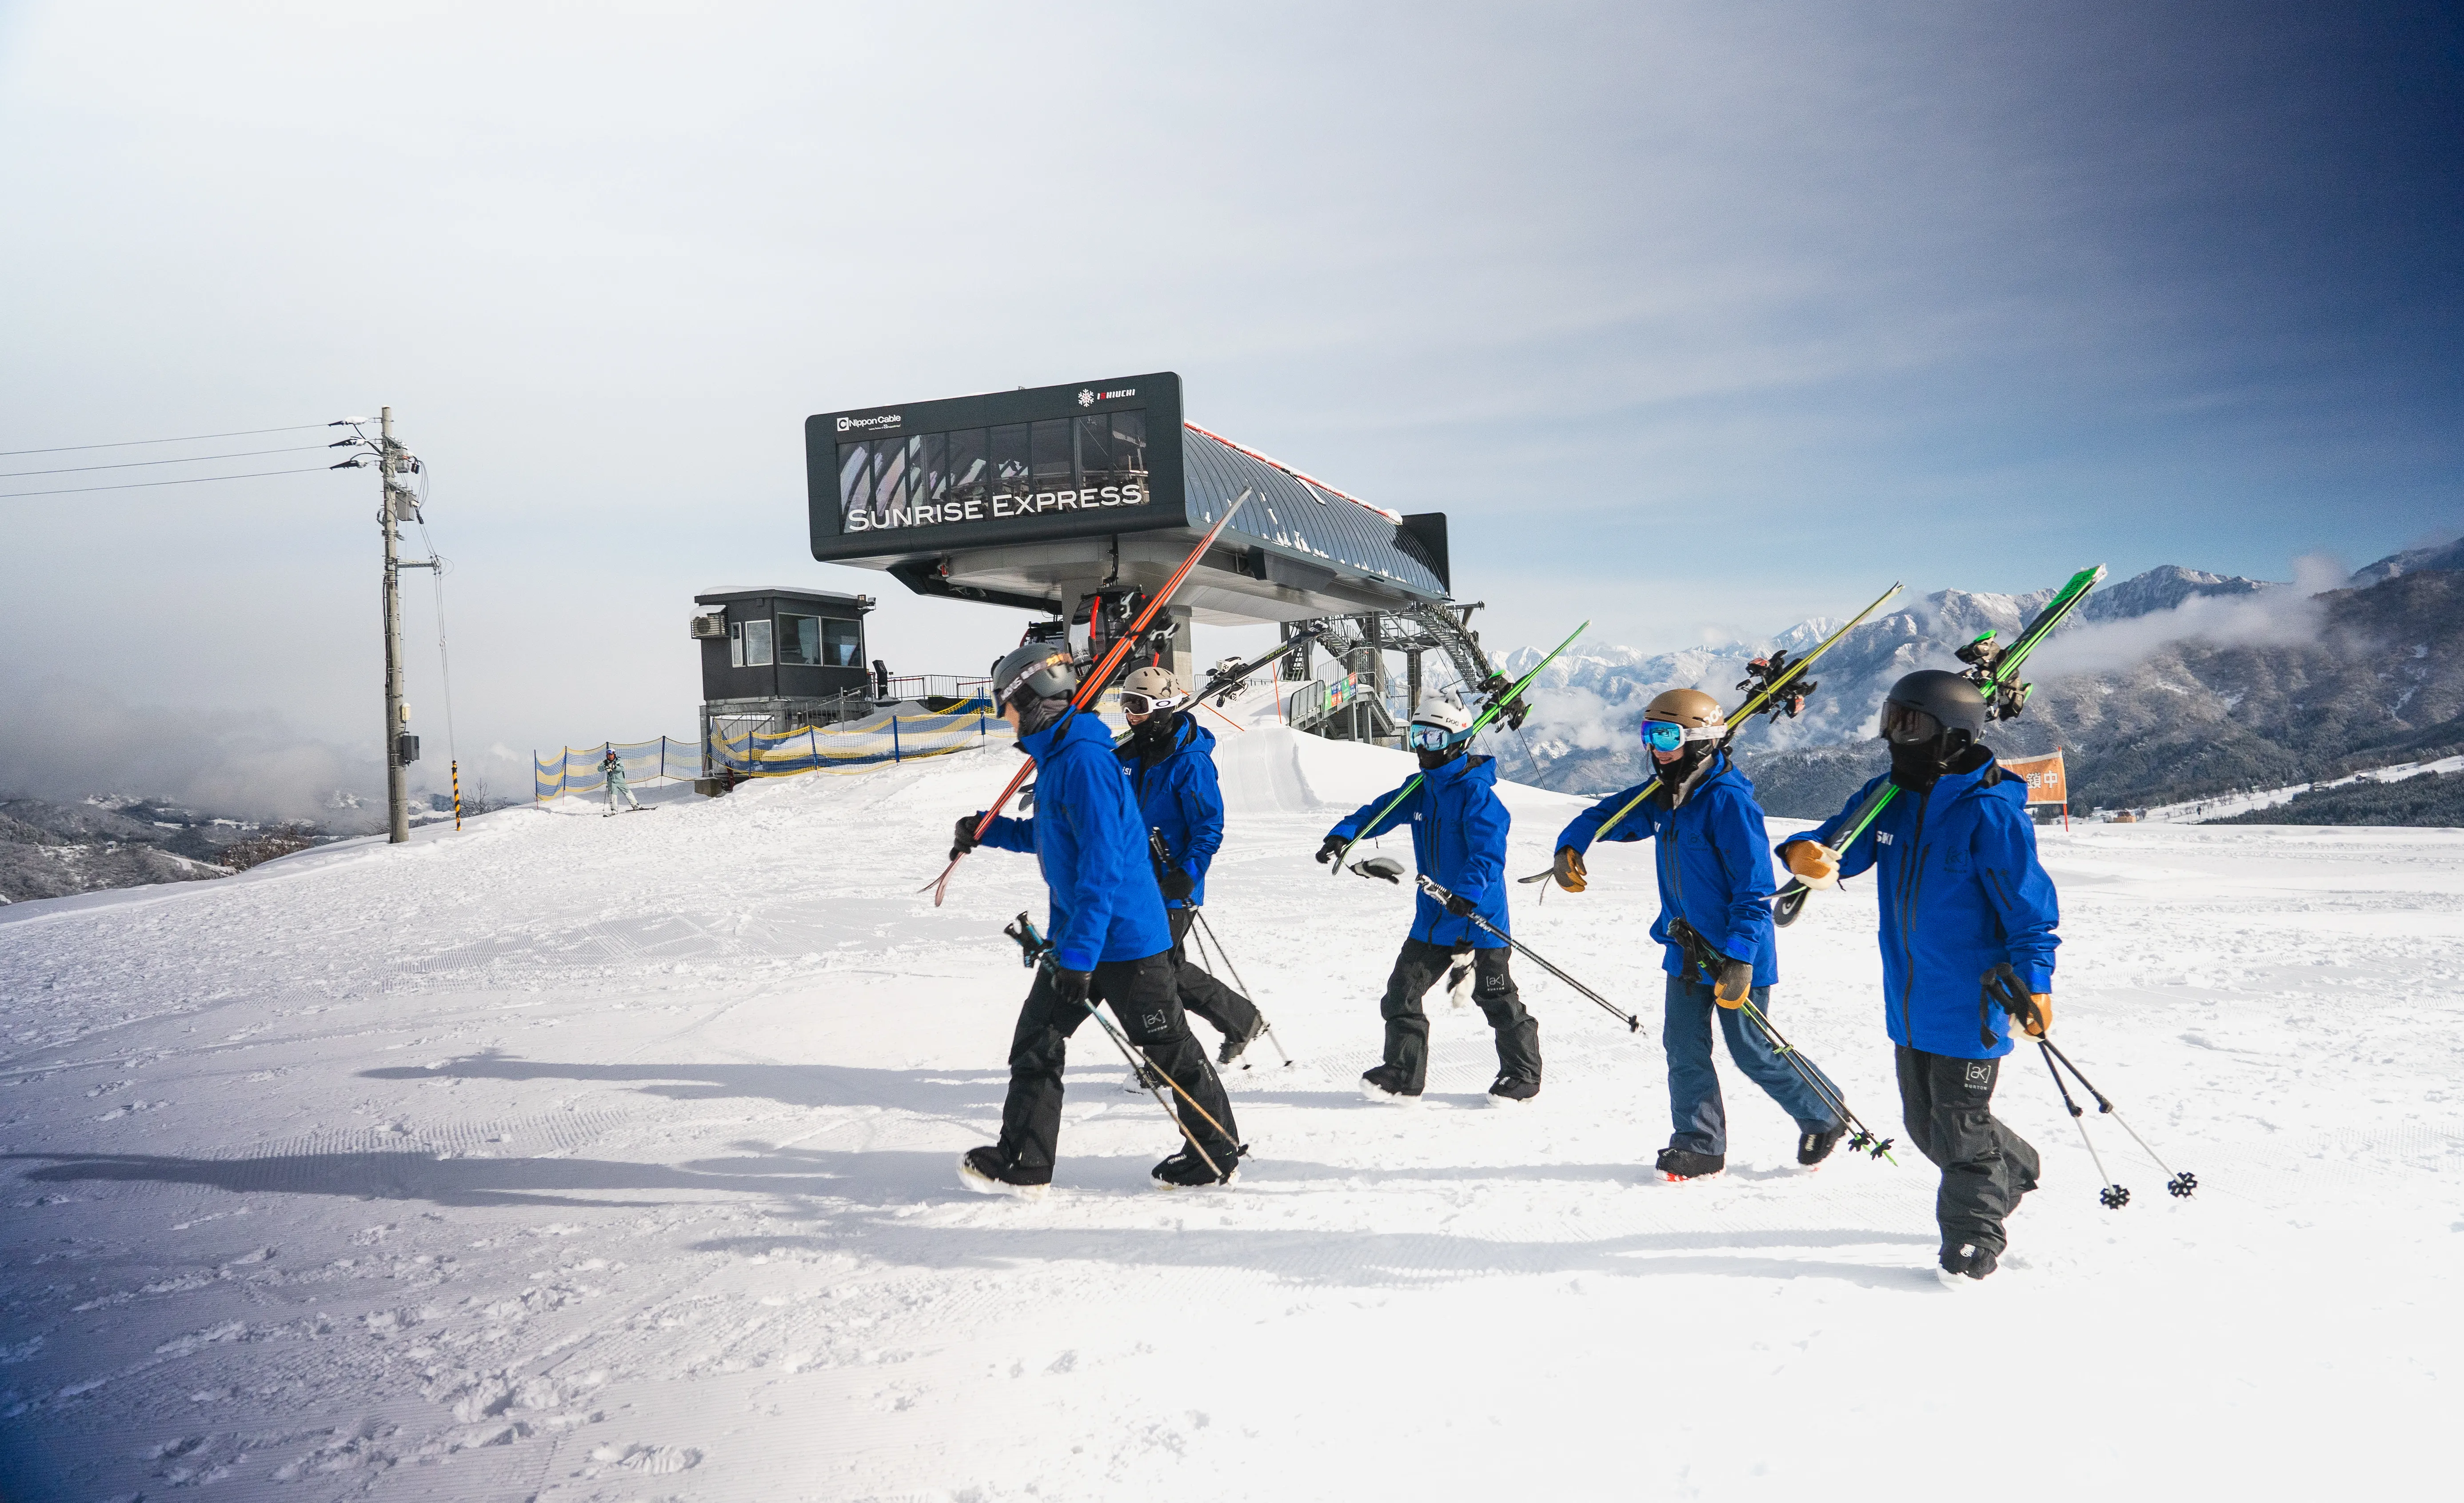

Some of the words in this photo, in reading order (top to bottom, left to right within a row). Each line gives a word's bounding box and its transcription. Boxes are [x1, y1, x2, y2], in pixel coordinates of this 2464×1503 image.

[849, 418, 878, 428] Nippon
[878, 414, 902, 424] Cable
[848, 500, 984, 532] SUNRISE
[992, 484, 1143, 517] EXPRESS
[2019, 770, 2058, 789] 鎖中
